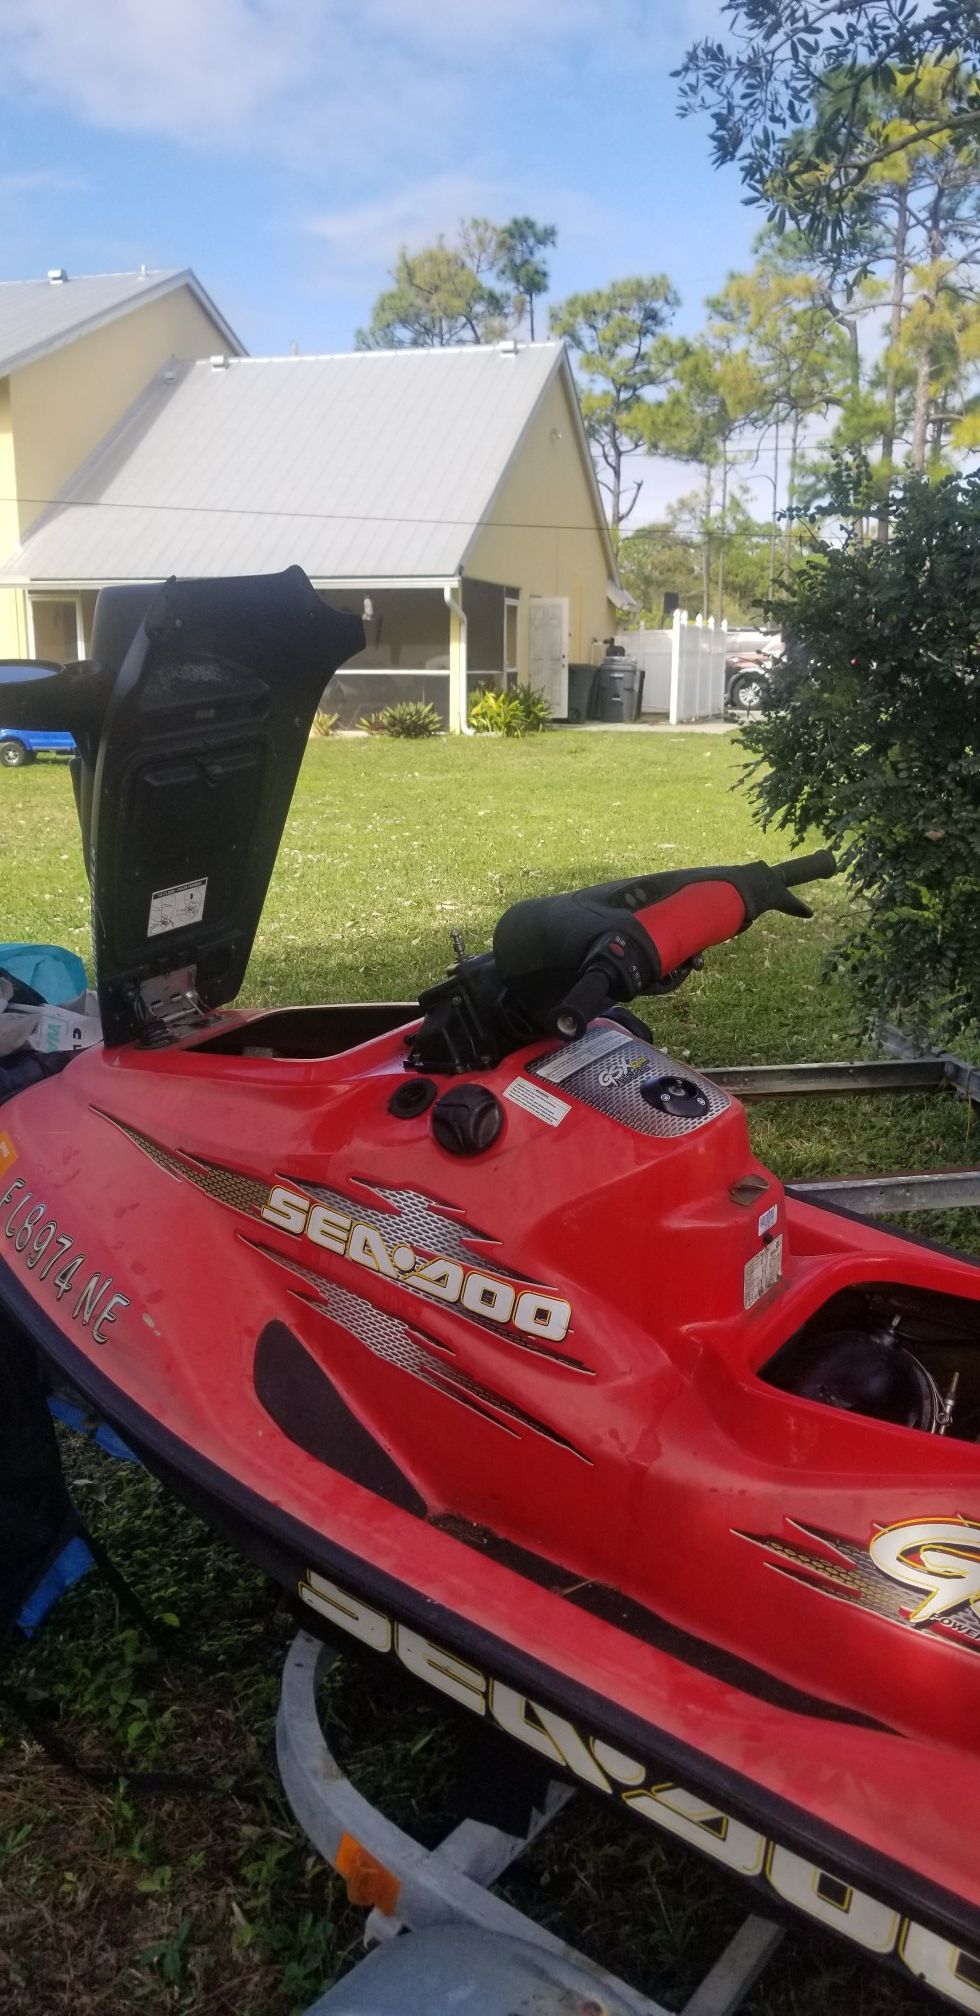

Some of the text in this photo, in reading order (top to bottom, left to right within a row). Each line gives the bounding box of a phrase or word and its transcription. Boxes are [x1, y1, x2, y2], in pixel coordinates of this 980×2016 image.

[598, 1056, 630, 1087] GSX
[72, 1272, 130, 1344] NE
[928, 1613, 980, 1640] POWE
